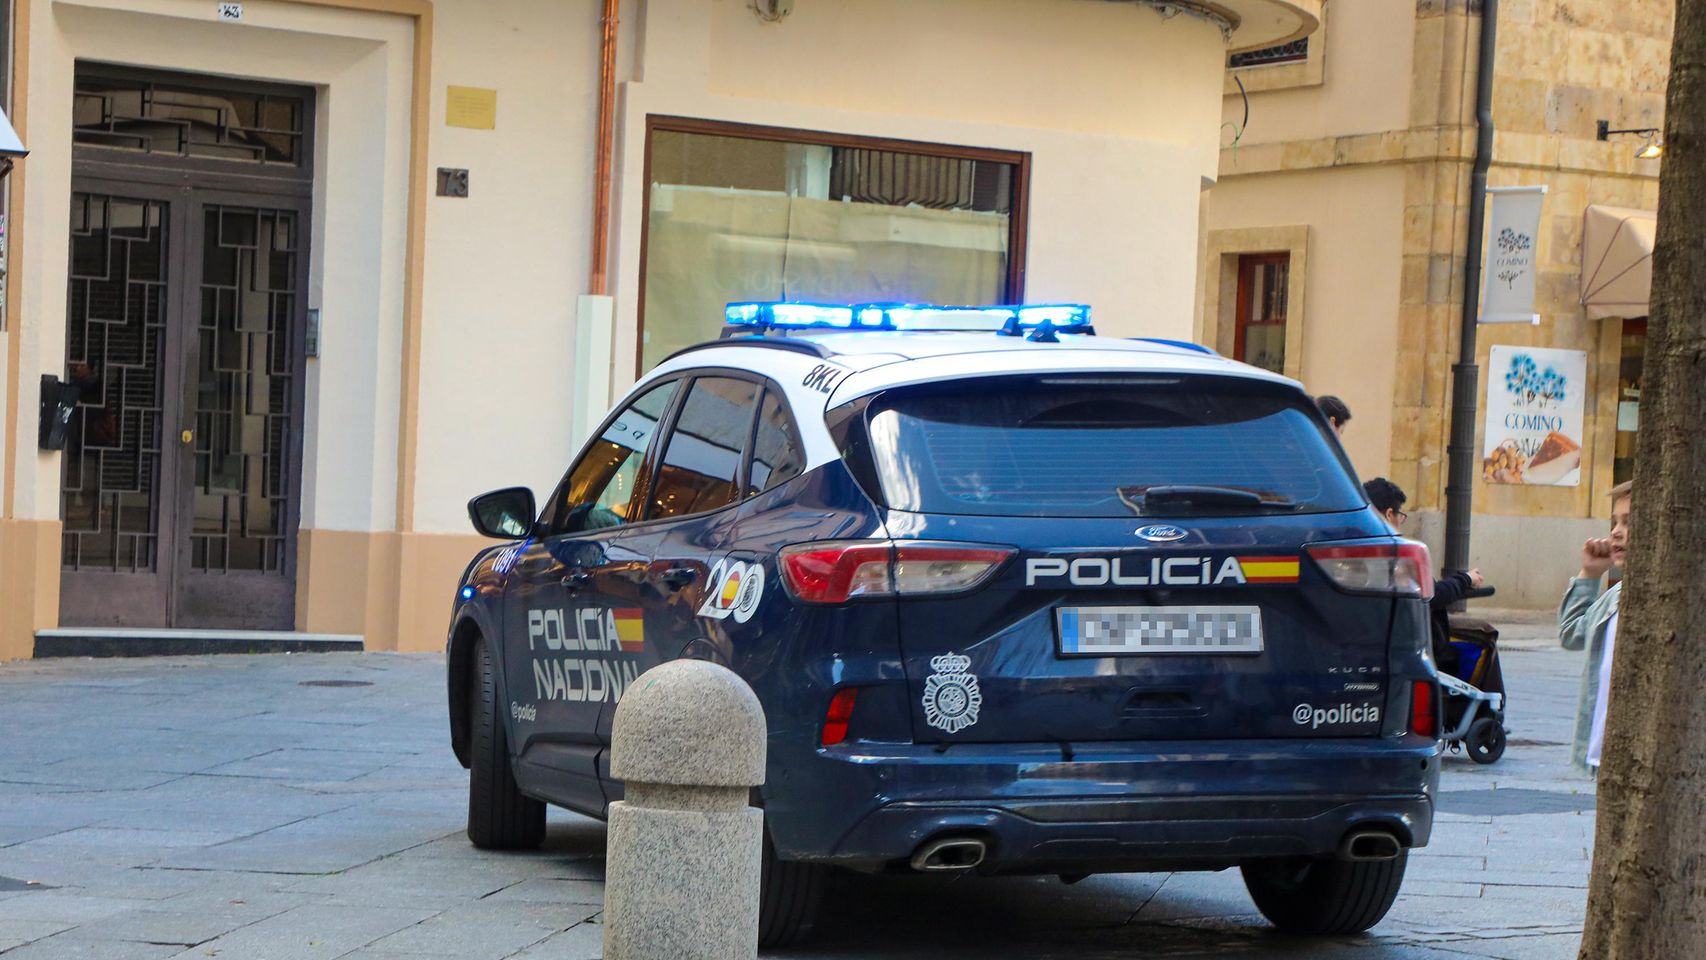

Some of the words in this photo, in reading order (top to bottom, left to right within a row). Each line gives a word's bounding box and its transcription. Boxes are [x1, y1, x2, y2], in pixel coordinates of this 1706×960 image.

[1504, 413, 1562, 433] COMINO
[1025, 556, 1246, 586] POLICÍA
[1292, 702, 1380, 729] @policia
